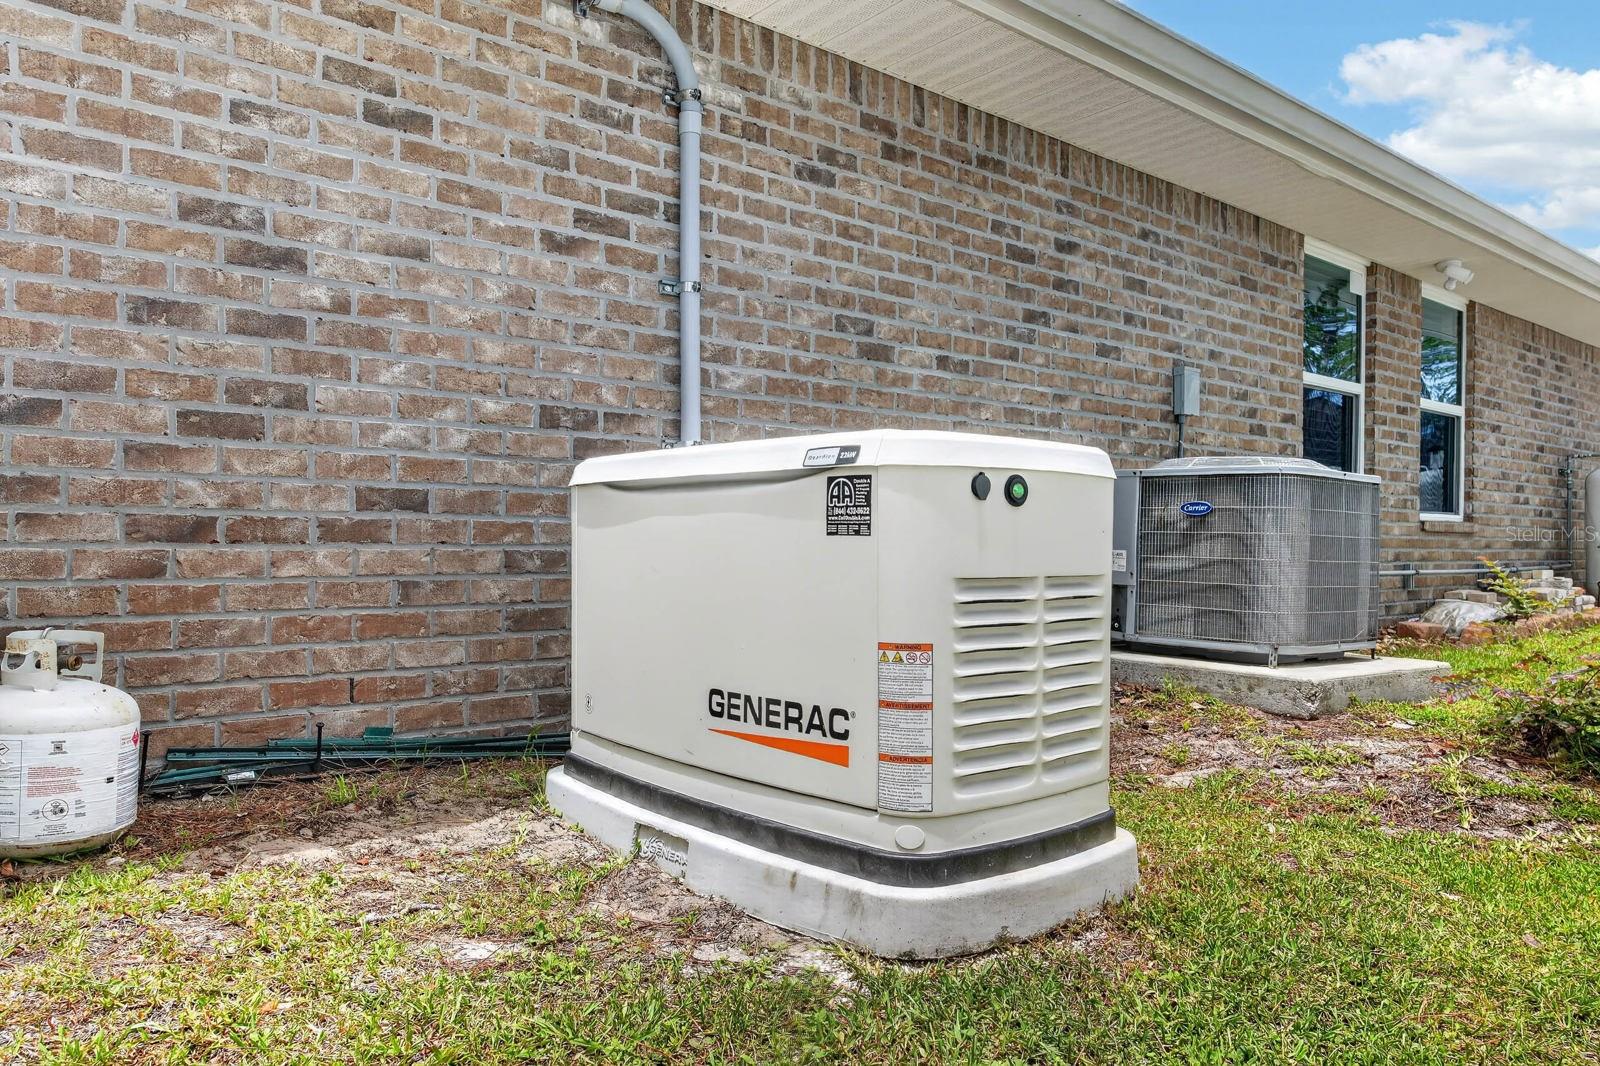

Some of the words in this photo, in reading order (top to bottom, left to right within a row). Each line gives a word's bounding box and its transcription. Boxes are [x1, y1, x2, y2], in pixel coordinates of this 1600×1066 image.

[840, 451, 857, 459] 22kW
[833, 506, 846, 516] (844)
[708, 688, 850, 741] GENERAC
[889, 755, 928, 763] ADVERTENCIA
